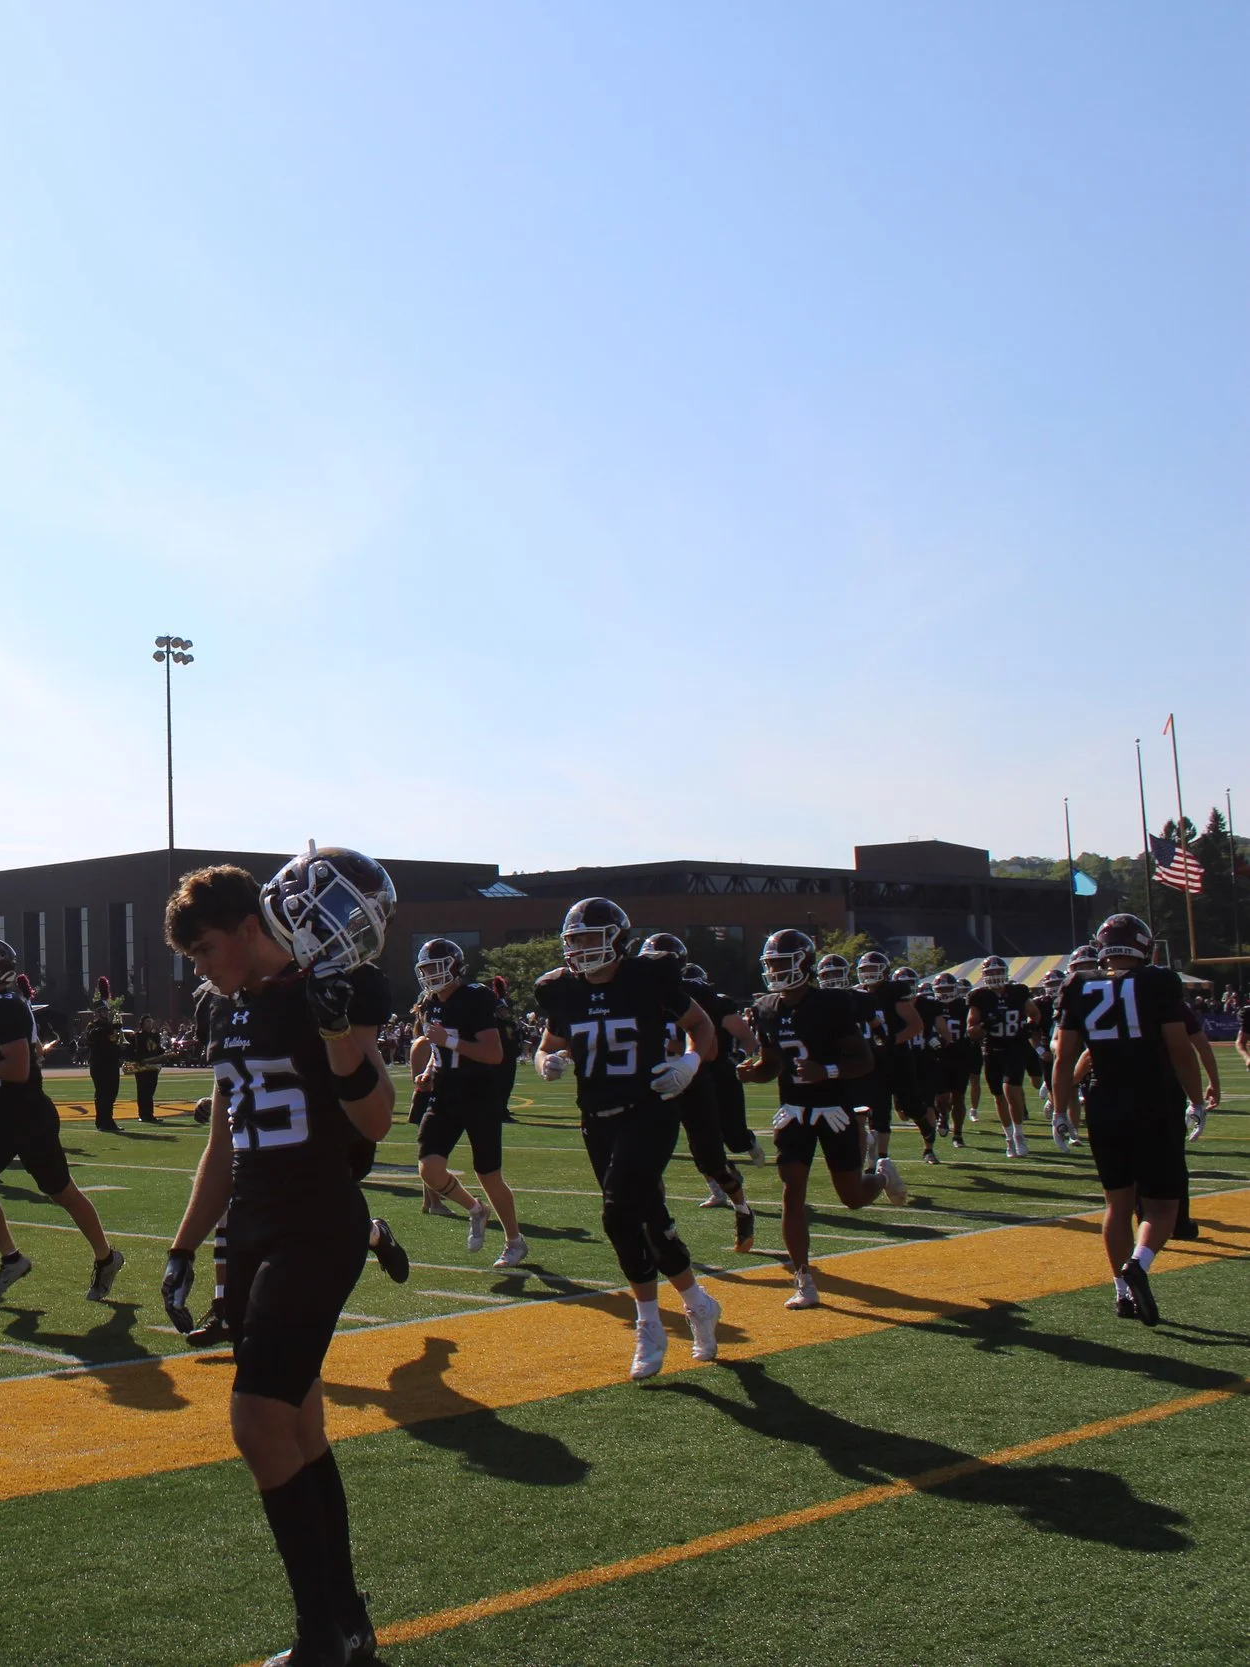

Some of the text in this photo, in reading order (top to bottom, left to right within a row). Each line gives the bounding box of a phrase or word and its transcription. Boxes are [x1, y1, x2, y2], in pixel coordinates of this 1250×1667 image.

[1082, 978, 1142, 1040] 21
[223, 1036, 251, 1051] Bulldogs
[570, 1018, 638, 1077] 75
